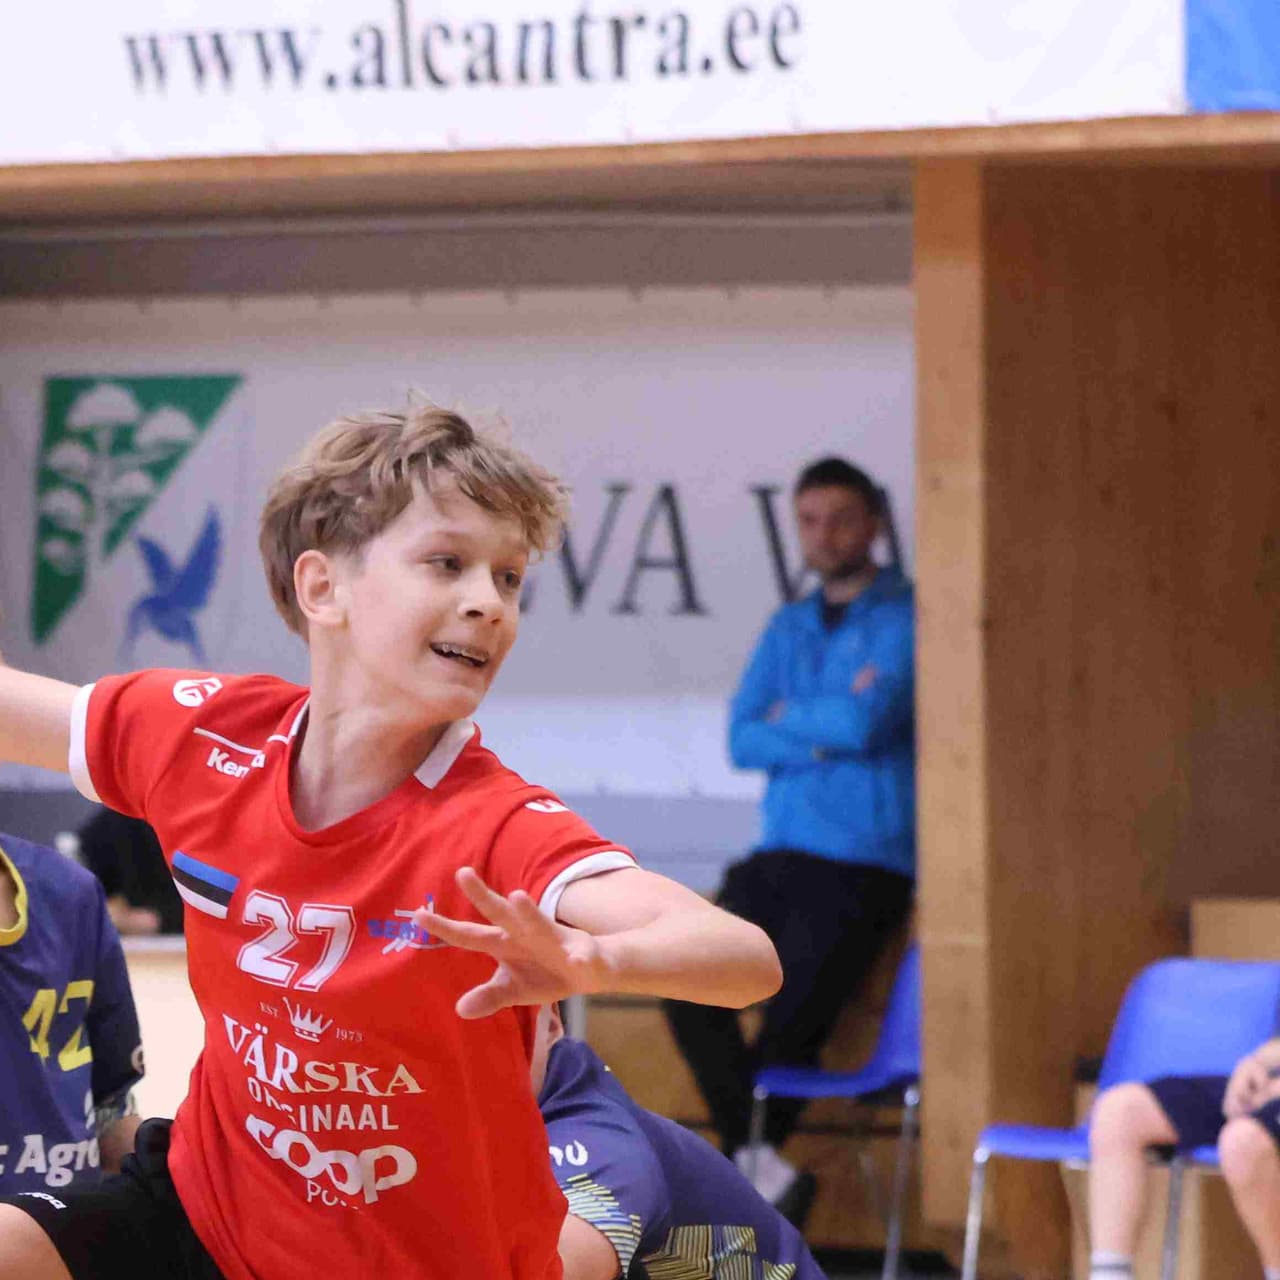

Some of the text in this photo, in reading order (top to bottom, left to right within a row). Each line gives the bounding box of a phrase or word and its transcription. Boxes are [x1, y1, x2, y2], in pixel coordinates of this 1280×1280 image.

[123, 0, 802, 92] www.alcantra.ee
[235, 889, 357, 994] 27
[222, 1013, 427, 1097] VÄRSKA
